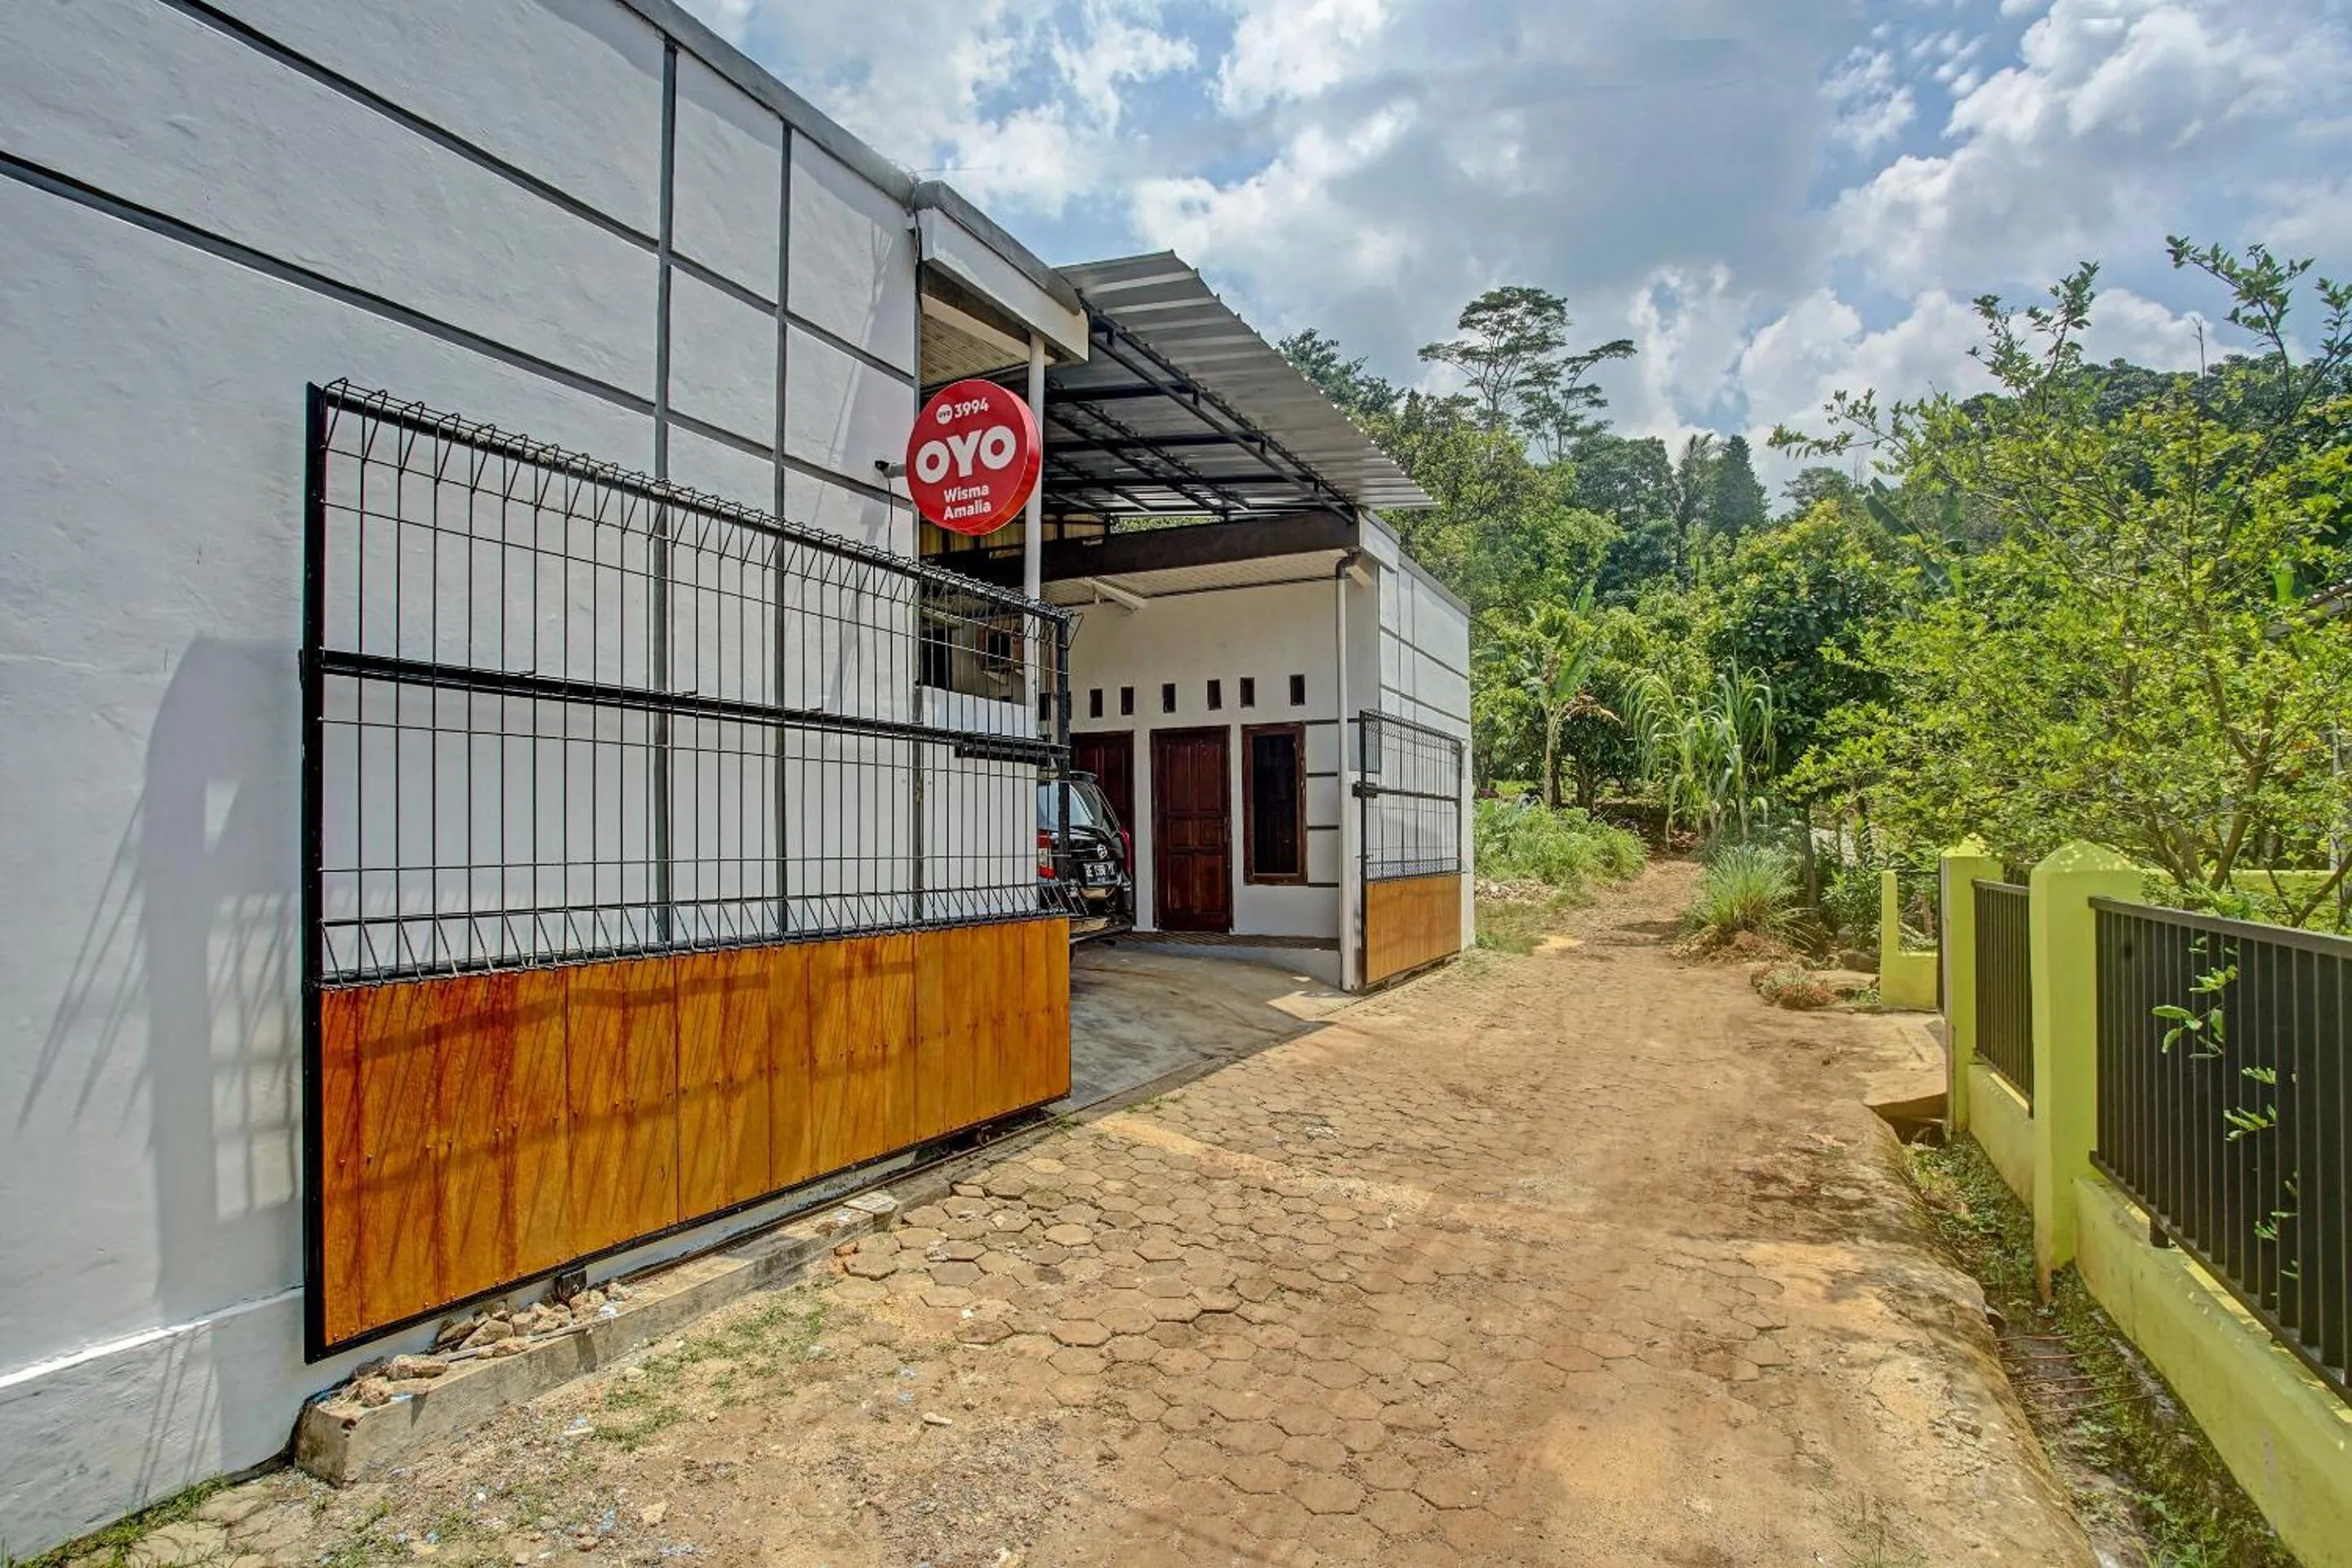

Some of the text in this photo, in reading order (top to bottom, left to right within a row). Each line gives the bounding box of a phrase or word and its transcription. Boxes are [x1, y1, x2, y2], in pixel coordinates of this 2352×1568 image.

[954, 397, 989, 418] 3994
[915, 425, 1017, 483] OYO
[943, 485, 990, 503] Wisma
[943, 499, 991, 521] Amalia
